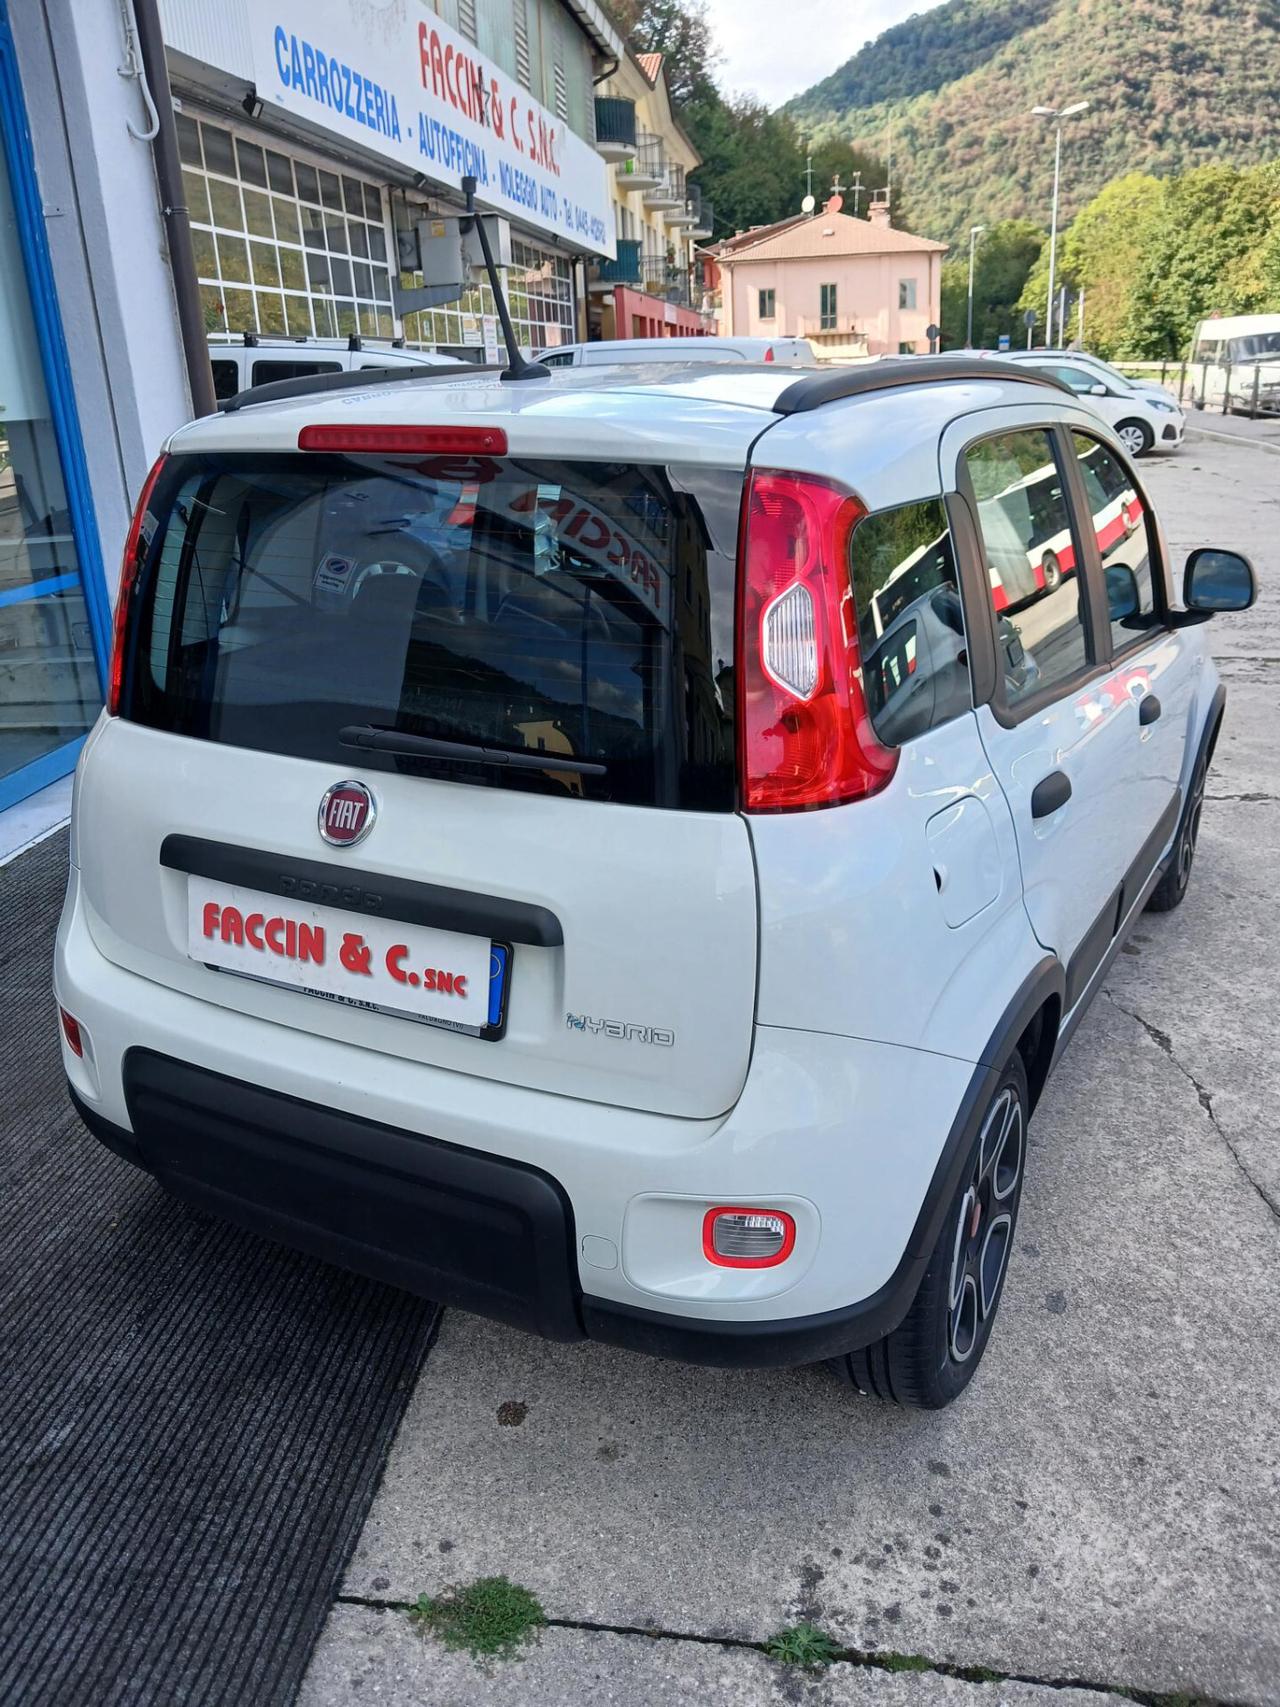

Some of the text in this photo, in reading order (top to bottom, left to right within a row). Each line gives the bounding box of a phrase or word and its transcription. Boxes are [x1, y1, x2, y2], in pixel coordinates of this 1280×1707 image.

[418, 21, 485, 128] FACCIN
[490, 78, 505, 140] &
[274, 25, 402, 143] CARROZZERIA
[419, 112, 489, 187] AUTOFFICINA
[499, 160, 538, 211] NOLEGGIO
[540, 184, 558, 222] AUTO
[328, 798, 365, 831] FIAT
[203, 902, 325, 965] FACCIN
[339, 932, 372, 976] &
[567, 1012, 675, 1047] HYBRID
